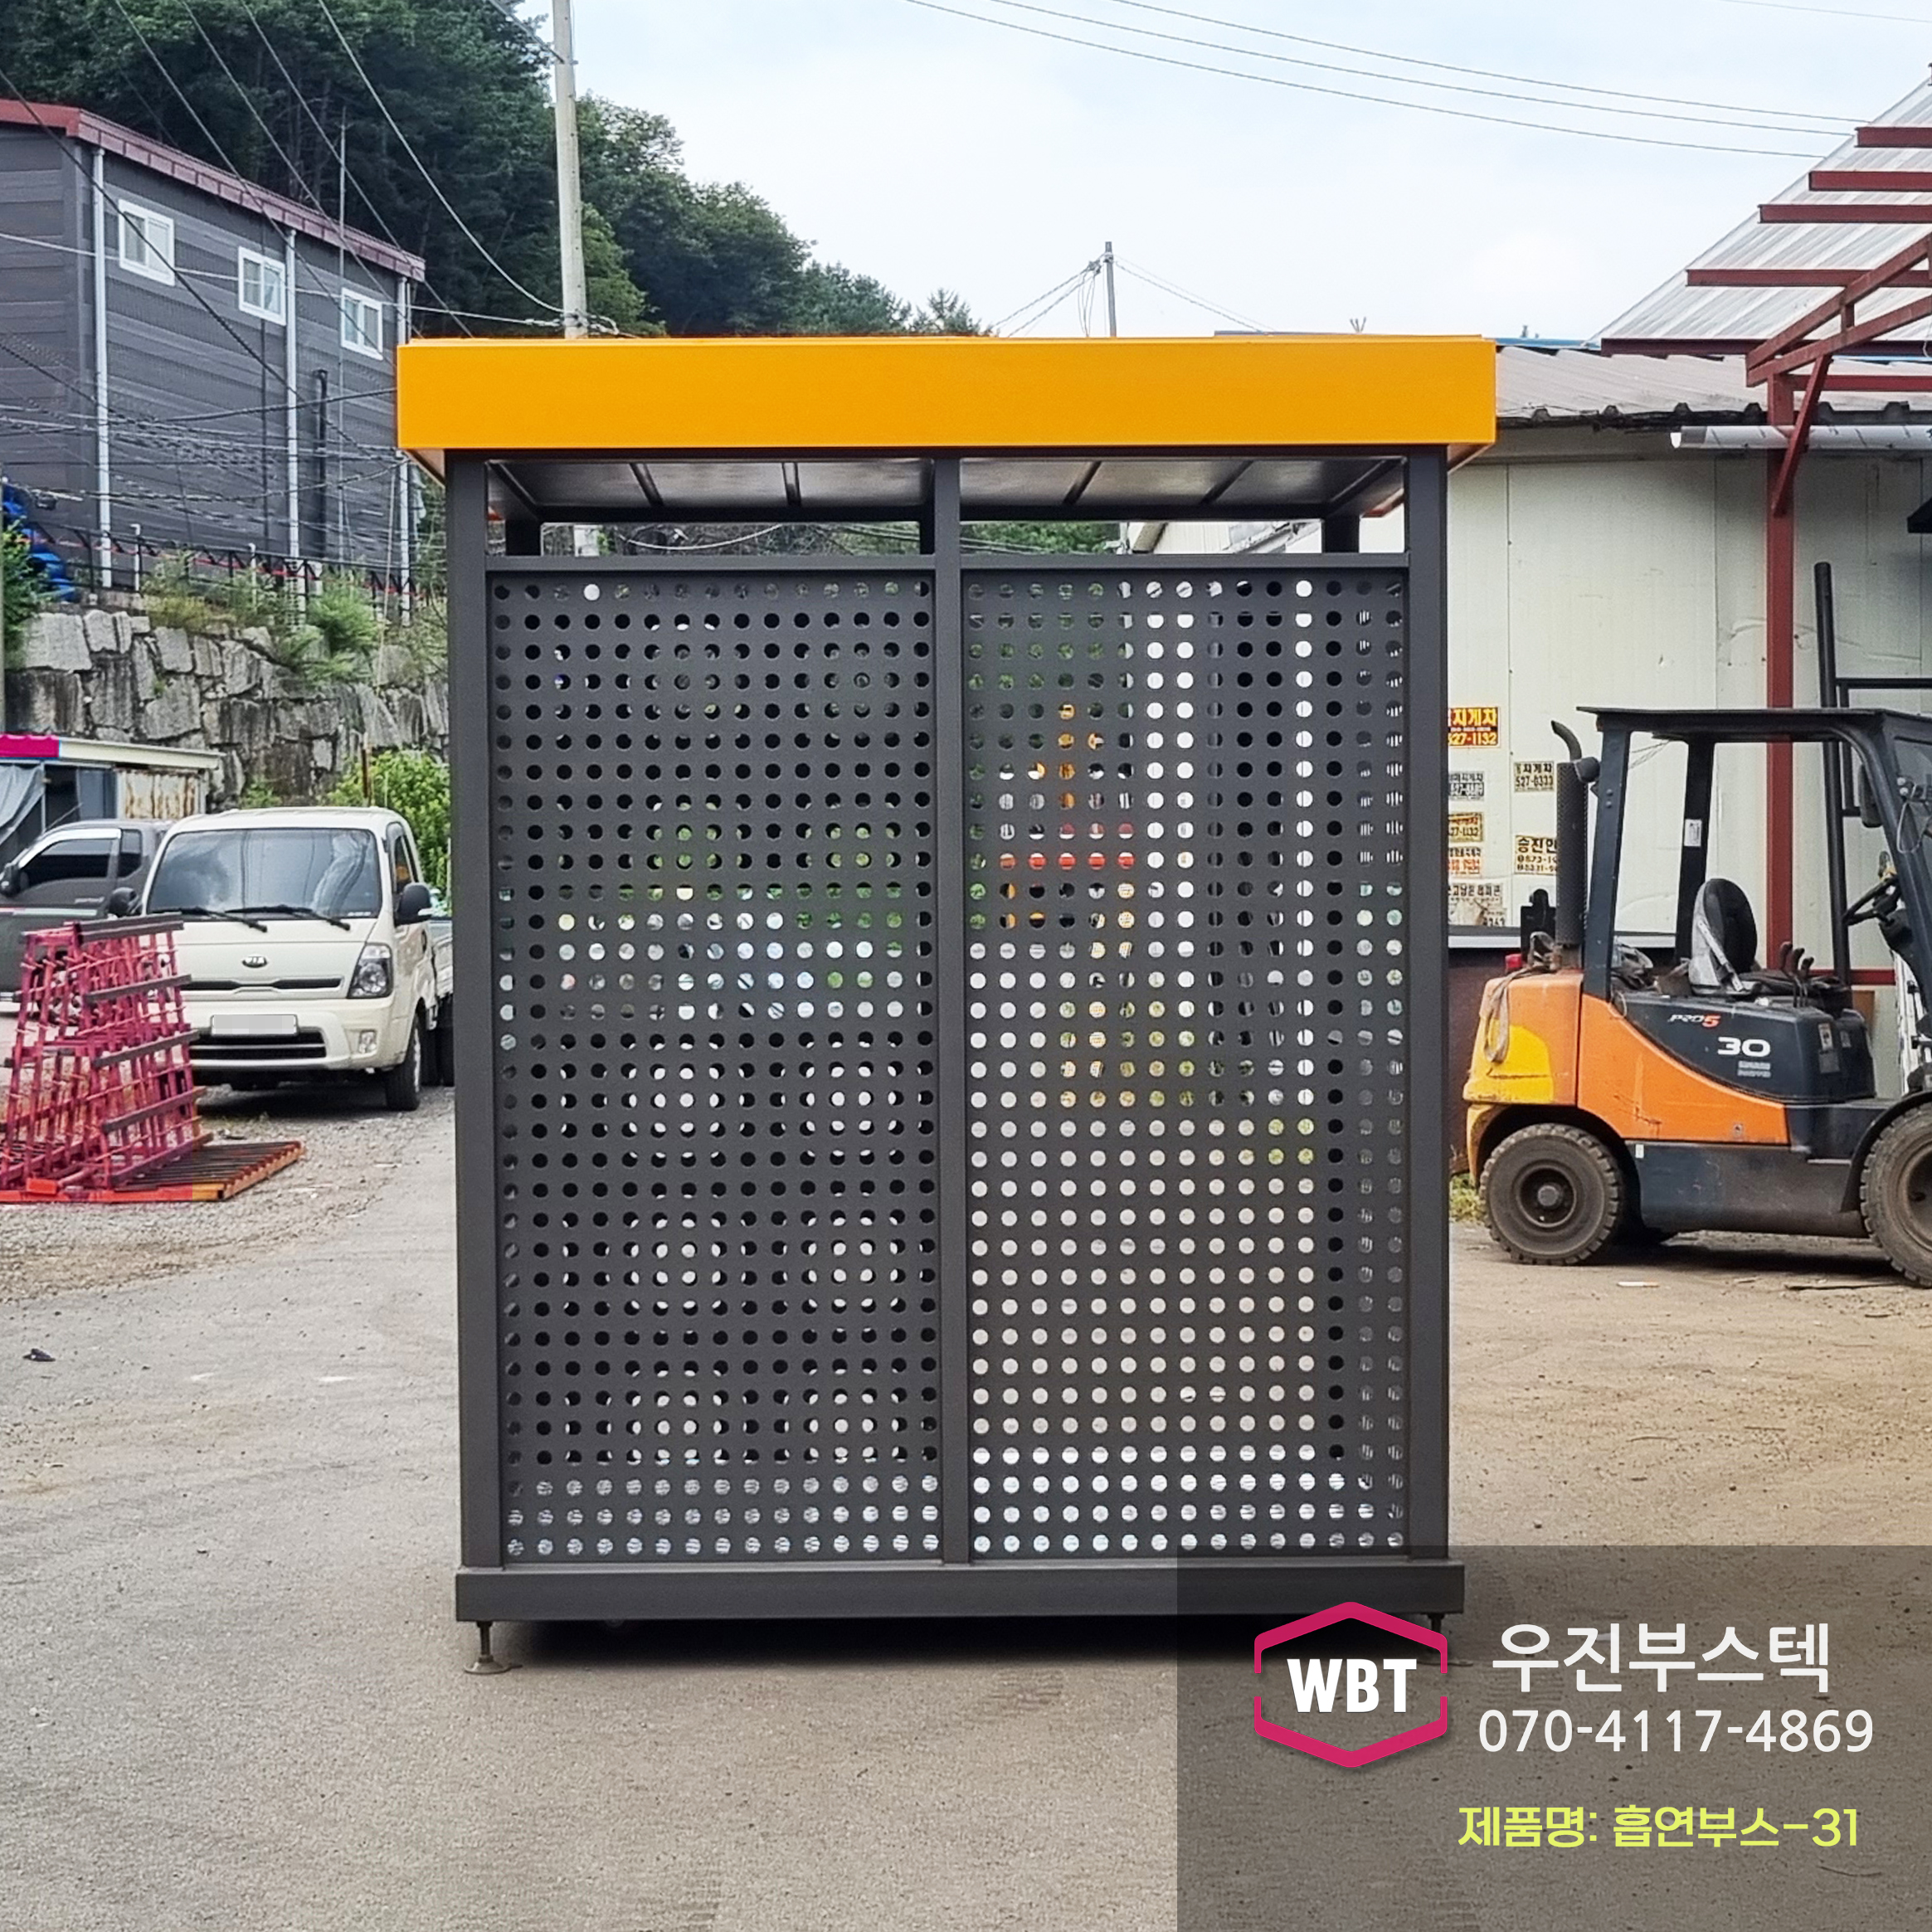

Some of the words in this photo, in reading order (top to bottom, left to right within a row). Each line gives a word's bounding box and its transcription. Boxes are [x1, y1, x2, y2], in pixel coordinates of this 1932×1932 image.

[1448, 708, 1496, 727] 지게차
[1667, 1014, 1721, 1028] PRO5
[1717, 1036, 1771, 1058] 30
